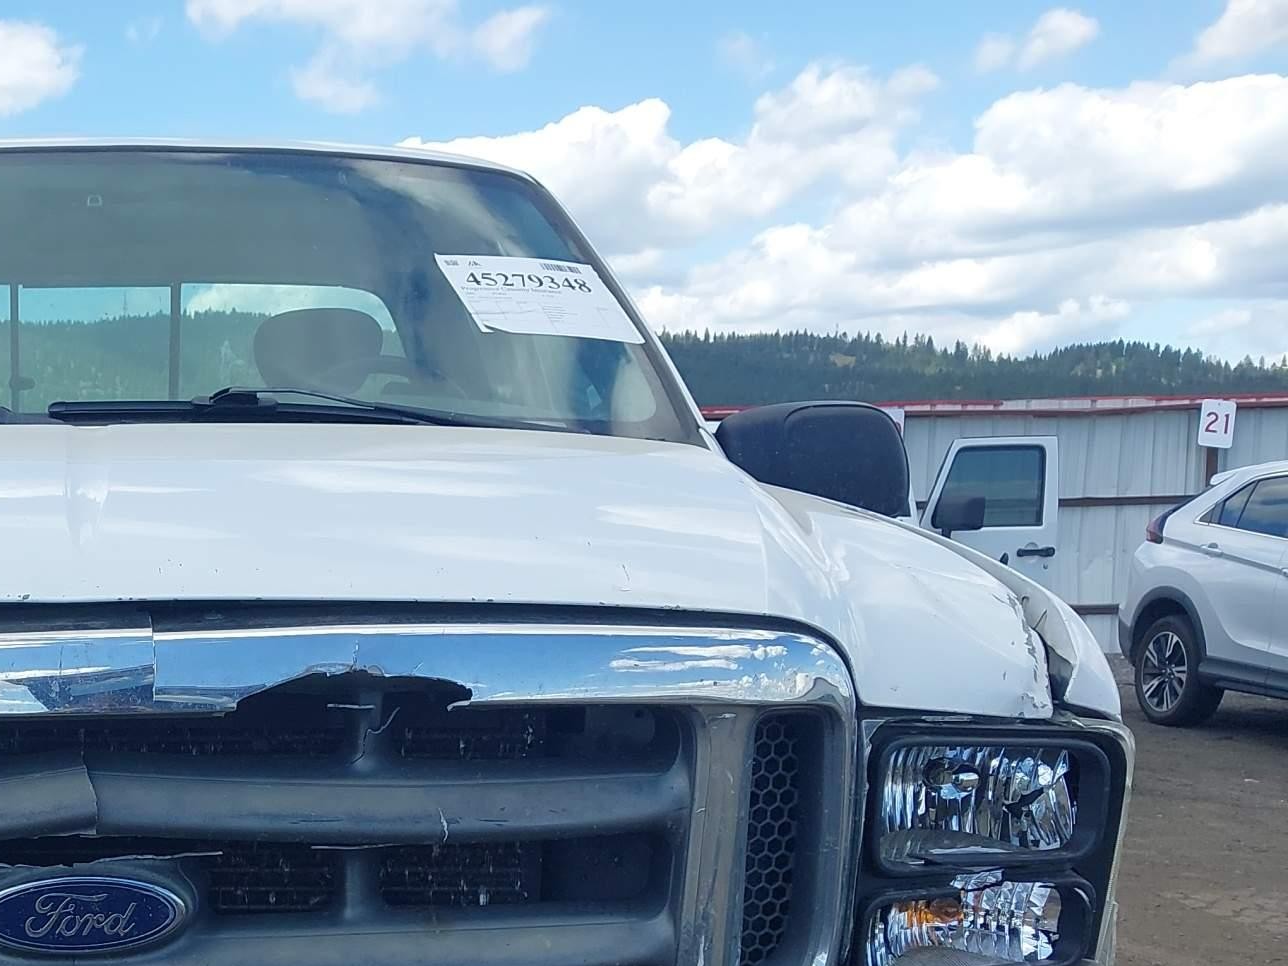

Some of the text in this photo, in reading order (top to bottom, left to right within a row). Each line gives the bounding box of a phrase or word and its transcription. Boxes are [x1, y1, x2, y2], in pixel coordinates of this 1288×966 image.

[466, 271, 593, 294] 45279348
[1204, 411, 1231, 435] 21
[25, 893, 137, 938] Ford
